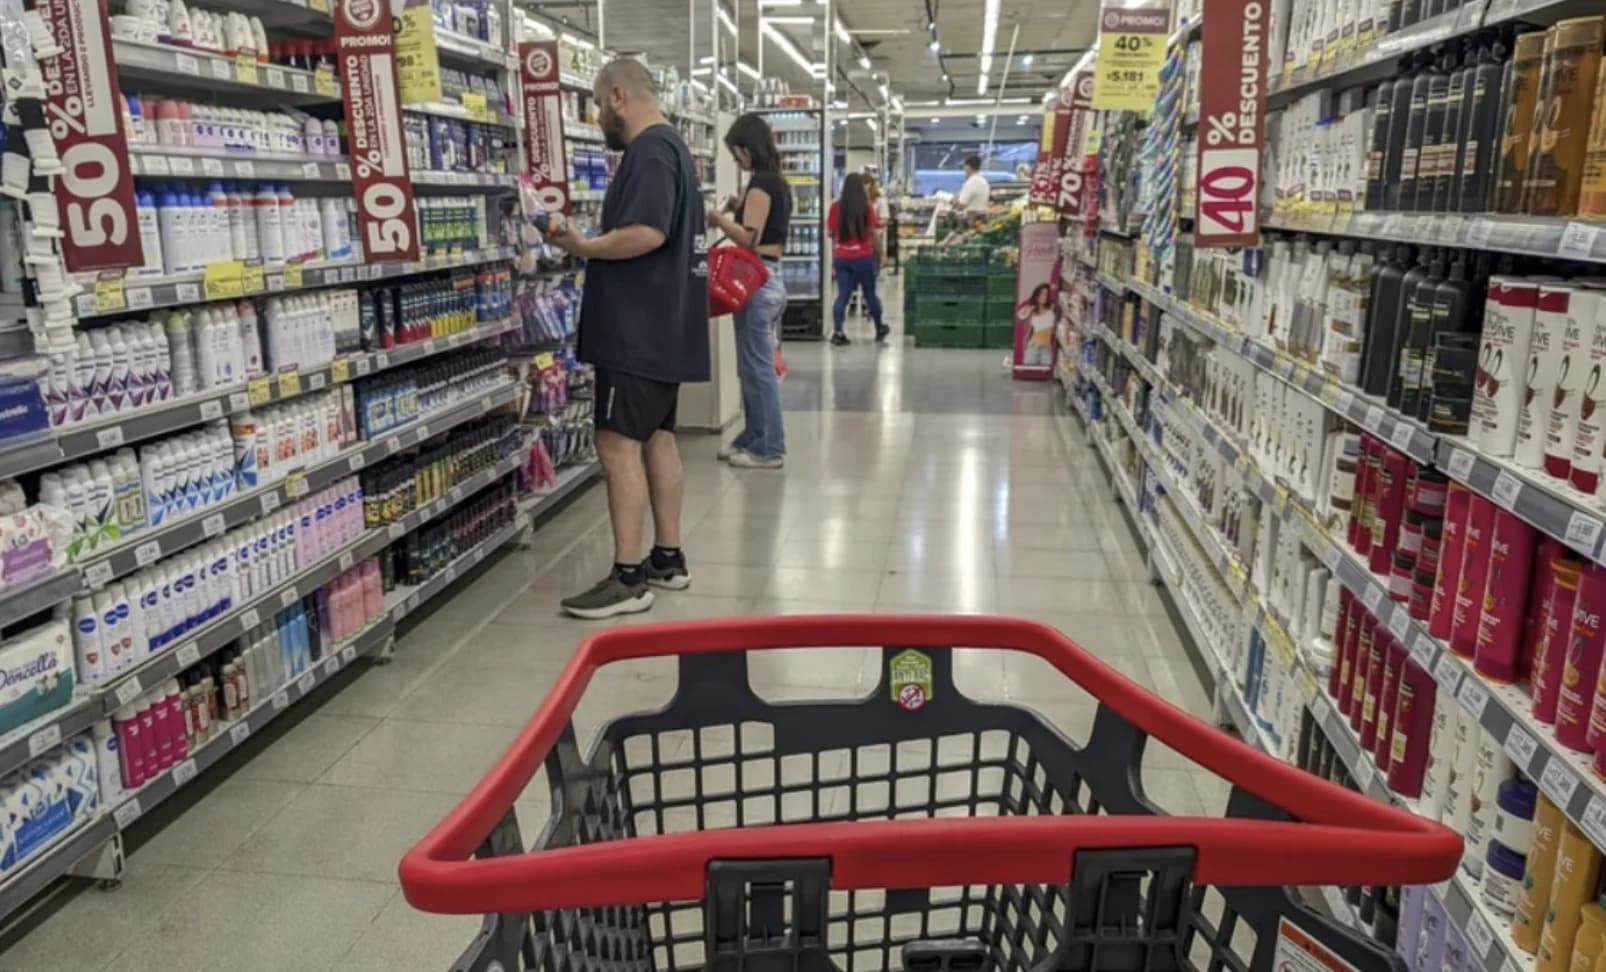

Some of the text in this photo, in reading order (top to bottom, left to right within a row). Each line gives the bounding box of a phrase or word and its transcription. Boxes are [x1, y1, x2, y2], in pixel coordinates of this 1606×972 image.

[1120, 16, 1165, 27] PROMO!
[340, 34, 391, 48] PROMO!
[62, 50, 75, 71] LA
[65, 72, 78, 94] EN
[1239, 2, 1263, 144] DESCUENTO
[346, 55, 368, 149] DESCUENTO
[528, 96, 540, 163] DESCUENTO
